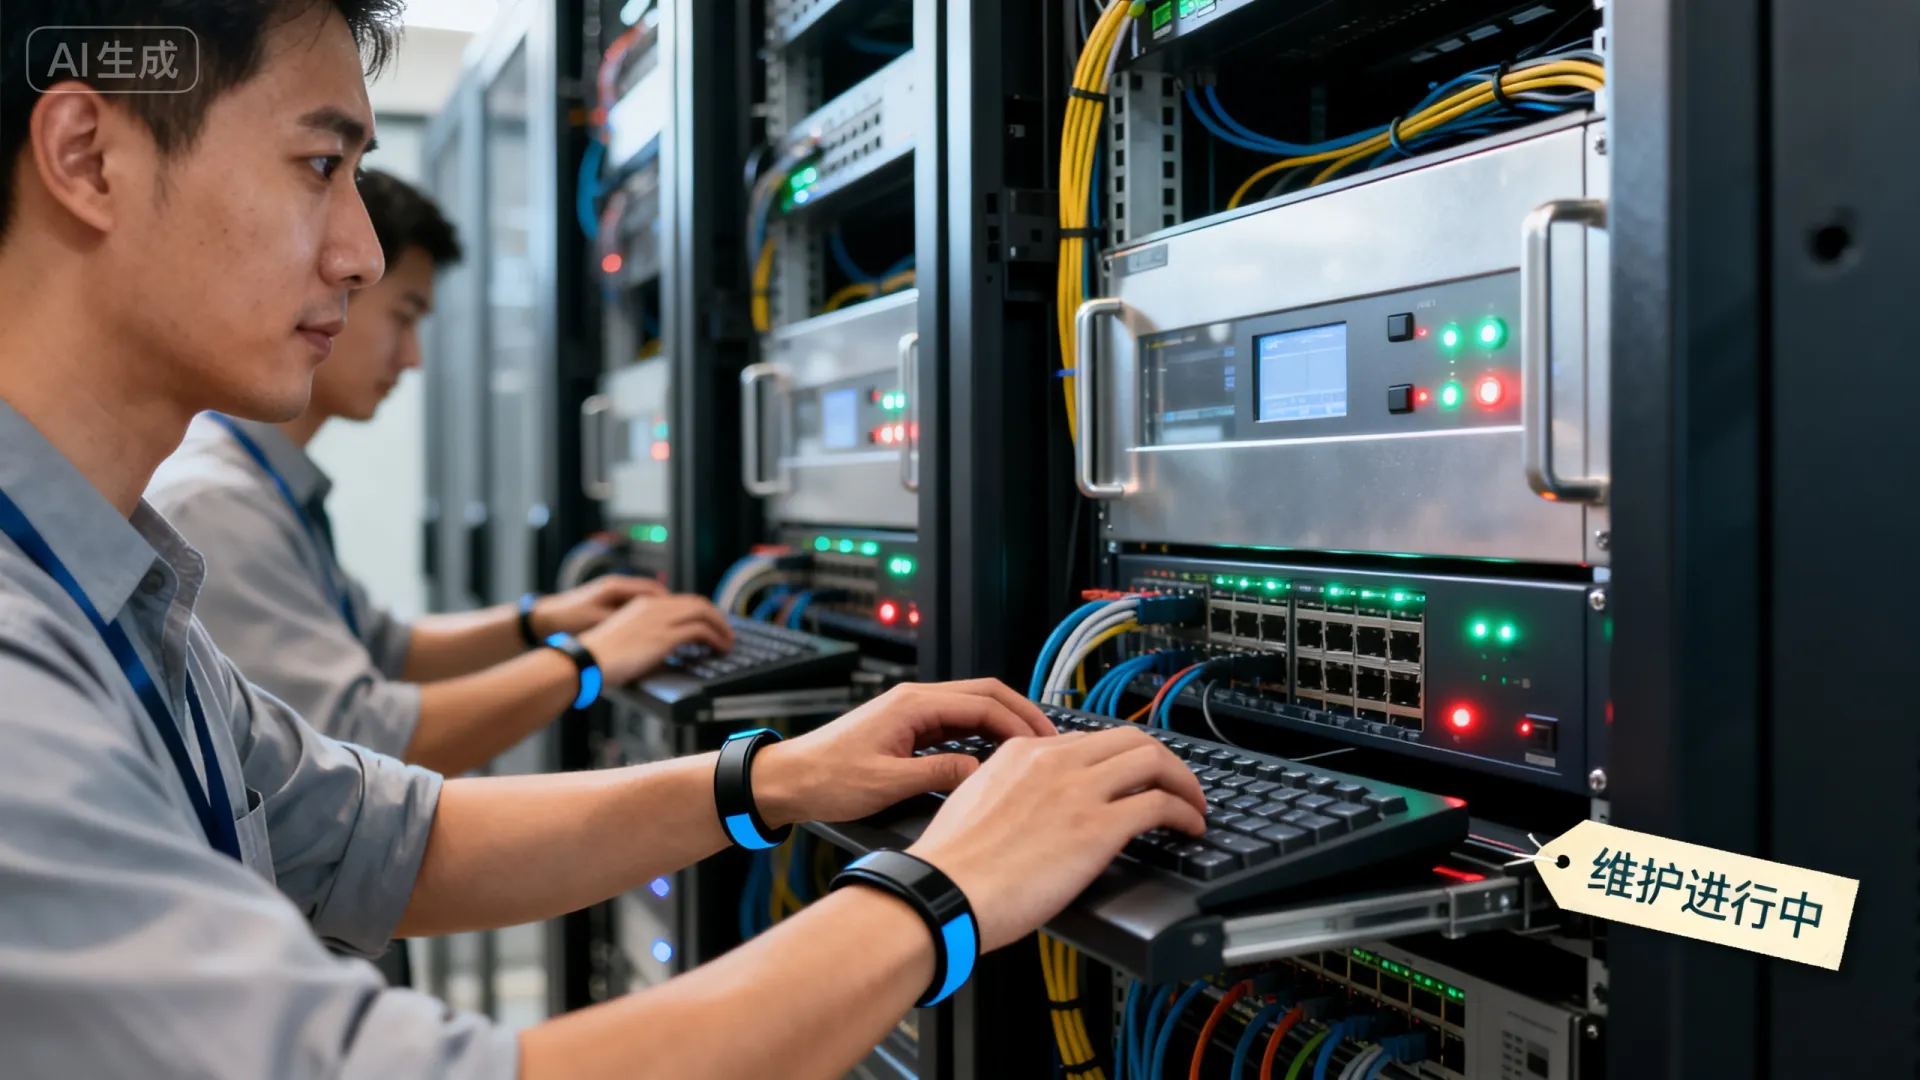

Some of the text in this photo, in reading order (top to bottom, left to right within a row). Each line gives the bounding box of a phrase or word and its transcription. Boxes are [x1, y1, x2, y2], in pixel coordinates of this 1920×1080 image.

[1587, 847, 1823, 939] 维护进行中
